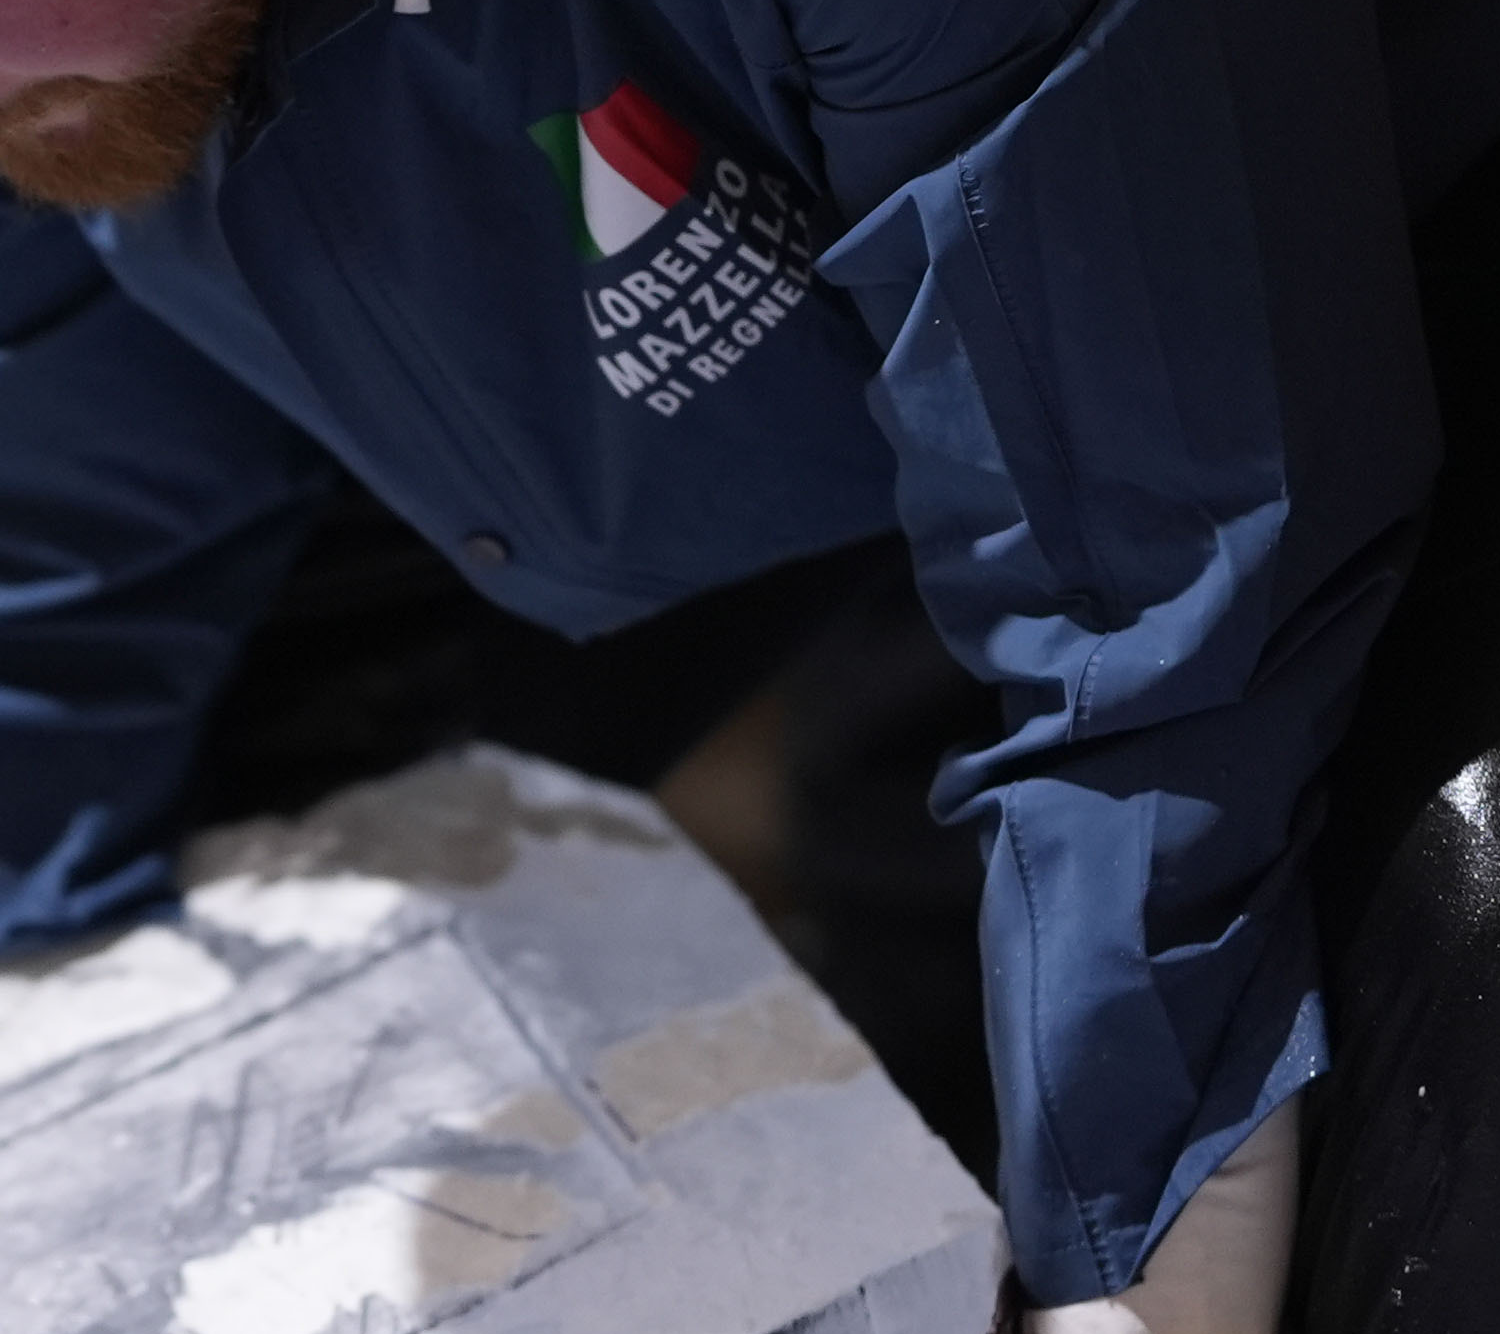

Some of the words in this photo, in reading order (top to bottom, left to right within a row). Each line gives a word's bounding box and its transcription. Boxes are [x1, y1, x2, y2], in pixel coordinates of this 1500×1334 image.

[583, 157, 748, 340] LORENZO
[597, 171, 789, 399] MAZZELLA
[645, 380, 694, 417] DI
